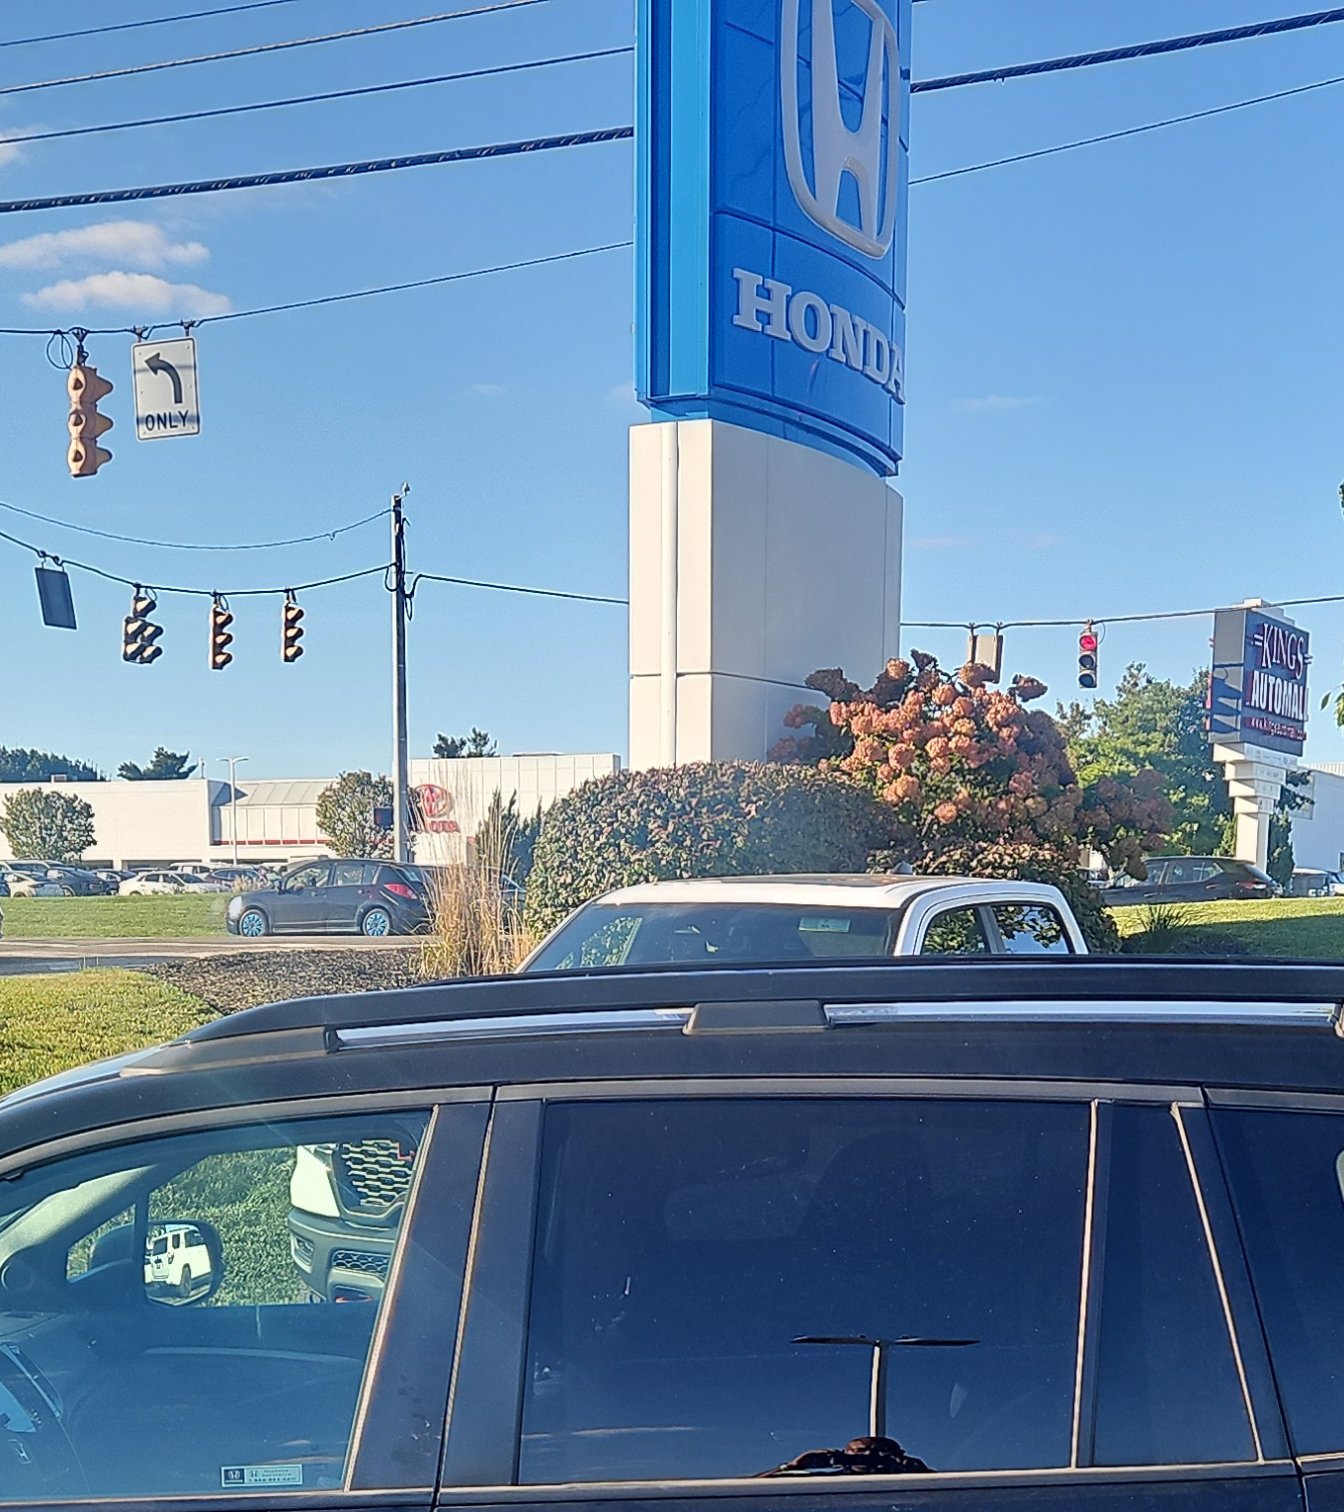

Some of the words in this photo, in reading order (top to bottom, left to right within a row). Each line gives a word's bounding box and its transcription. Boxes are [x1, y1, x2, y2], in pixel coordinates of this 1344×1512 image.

[732, 268, 905, 404] HONDA
[145, 410, 190, 431] ONLY
[1261, 623, 1305, 680] KINGS
[1250, 670, 1309, 721] AUTOMALL
